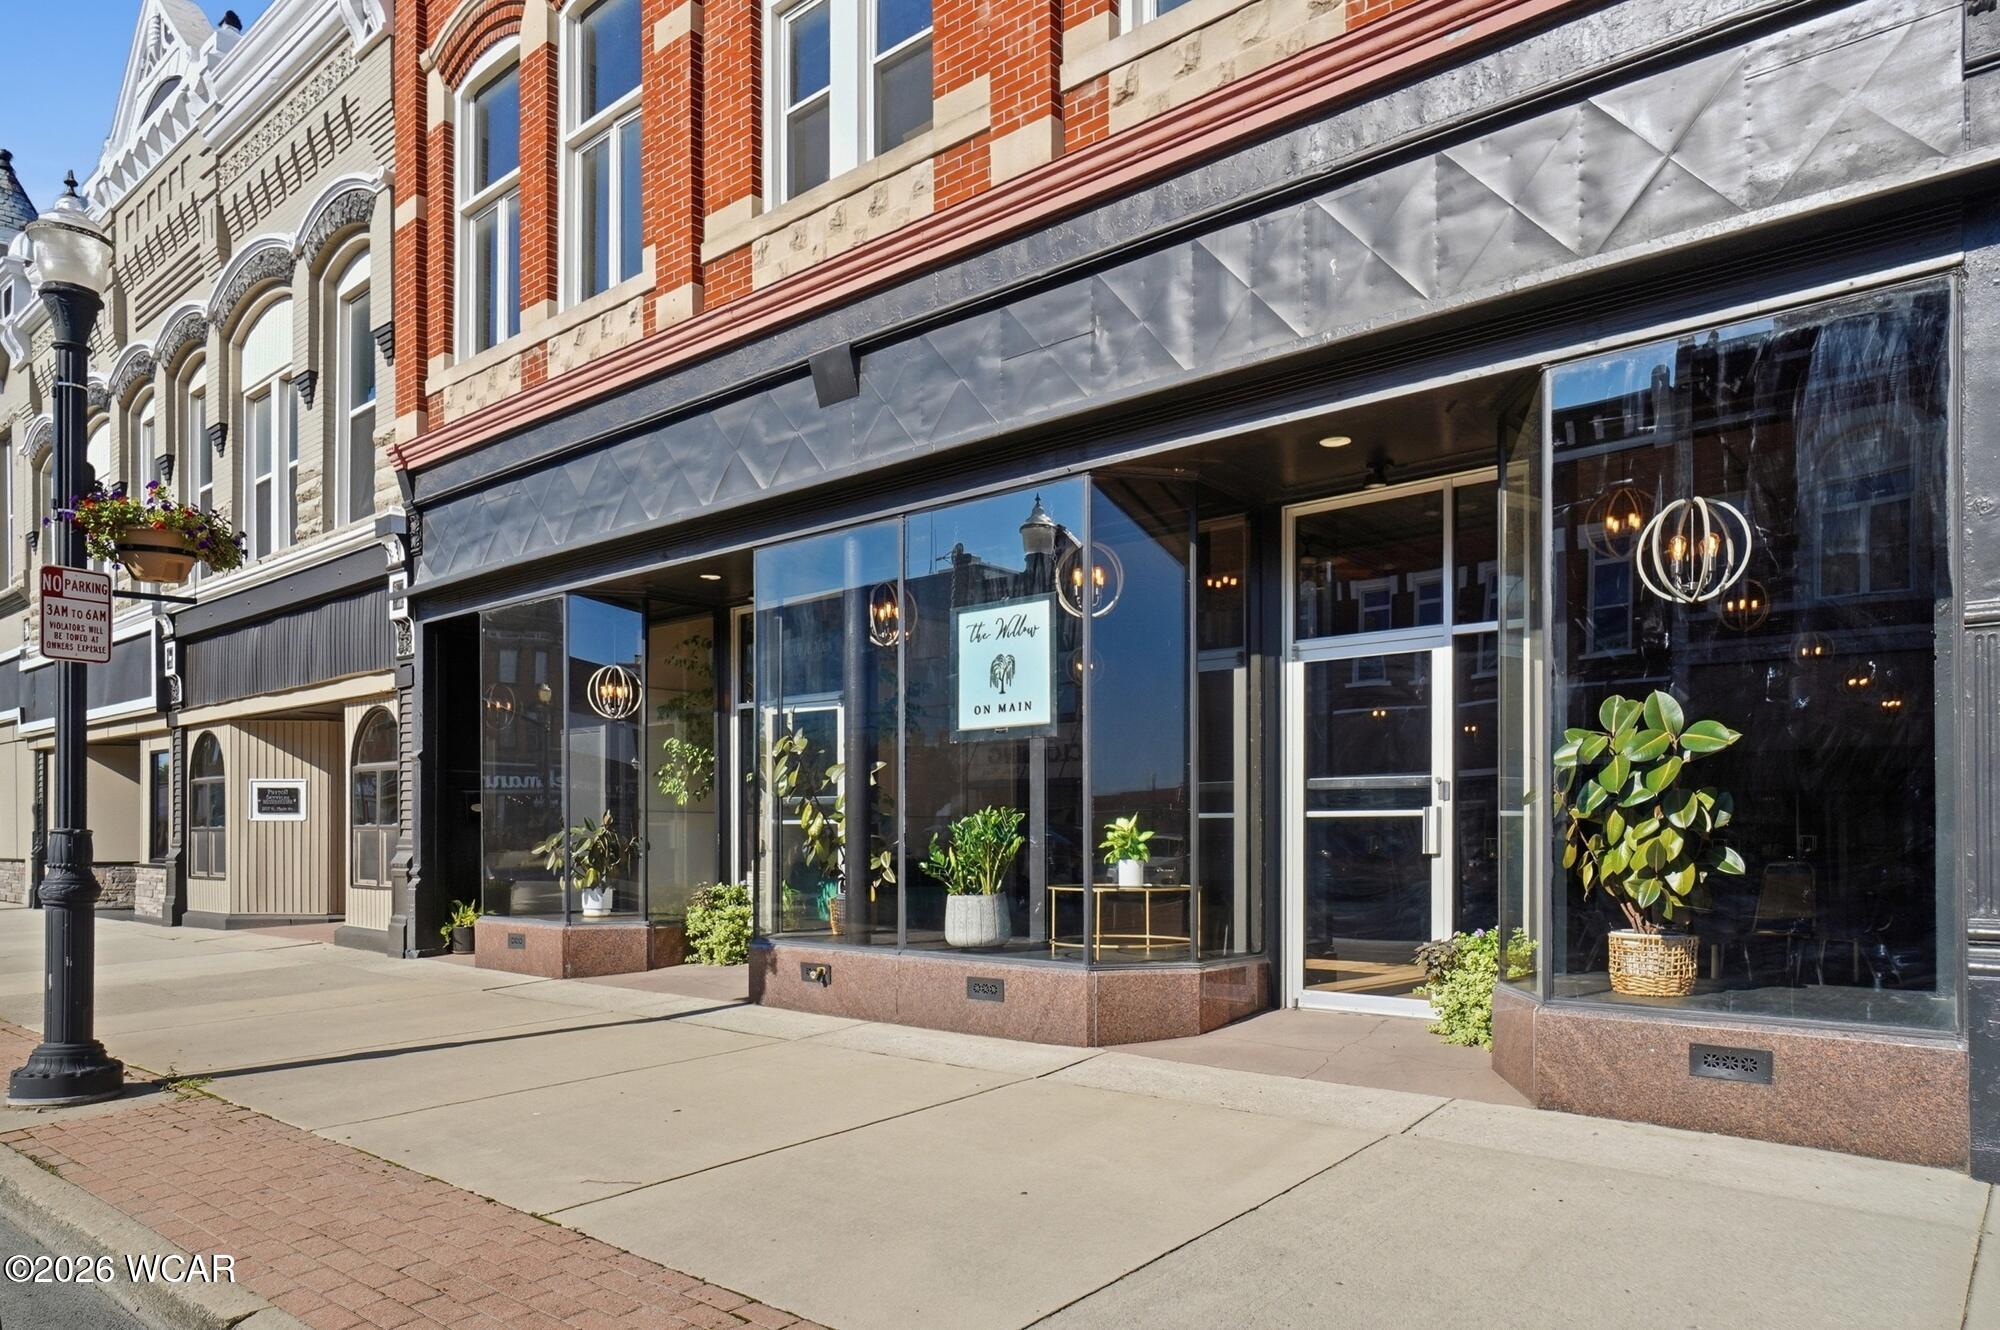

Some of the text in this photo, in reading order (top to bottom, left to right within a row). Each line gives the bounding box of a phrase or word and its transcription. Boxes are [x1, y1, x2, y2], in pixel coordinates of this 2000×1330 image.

[43, 573, 108, 596] NO PARKING
[46, 603, 106, 622] 3AM TO 6AM
[49, 620, 103, 635] VIOLATORS WILL
[995, 614, 1040, 640] Willow
[54, 632, 62, 640] BE
[66, 633, 88, 642] TOWED
[46, 641, 106, 655] OWNERS EXPENSE
[974, 701, 1032, 715] ON MAIN
